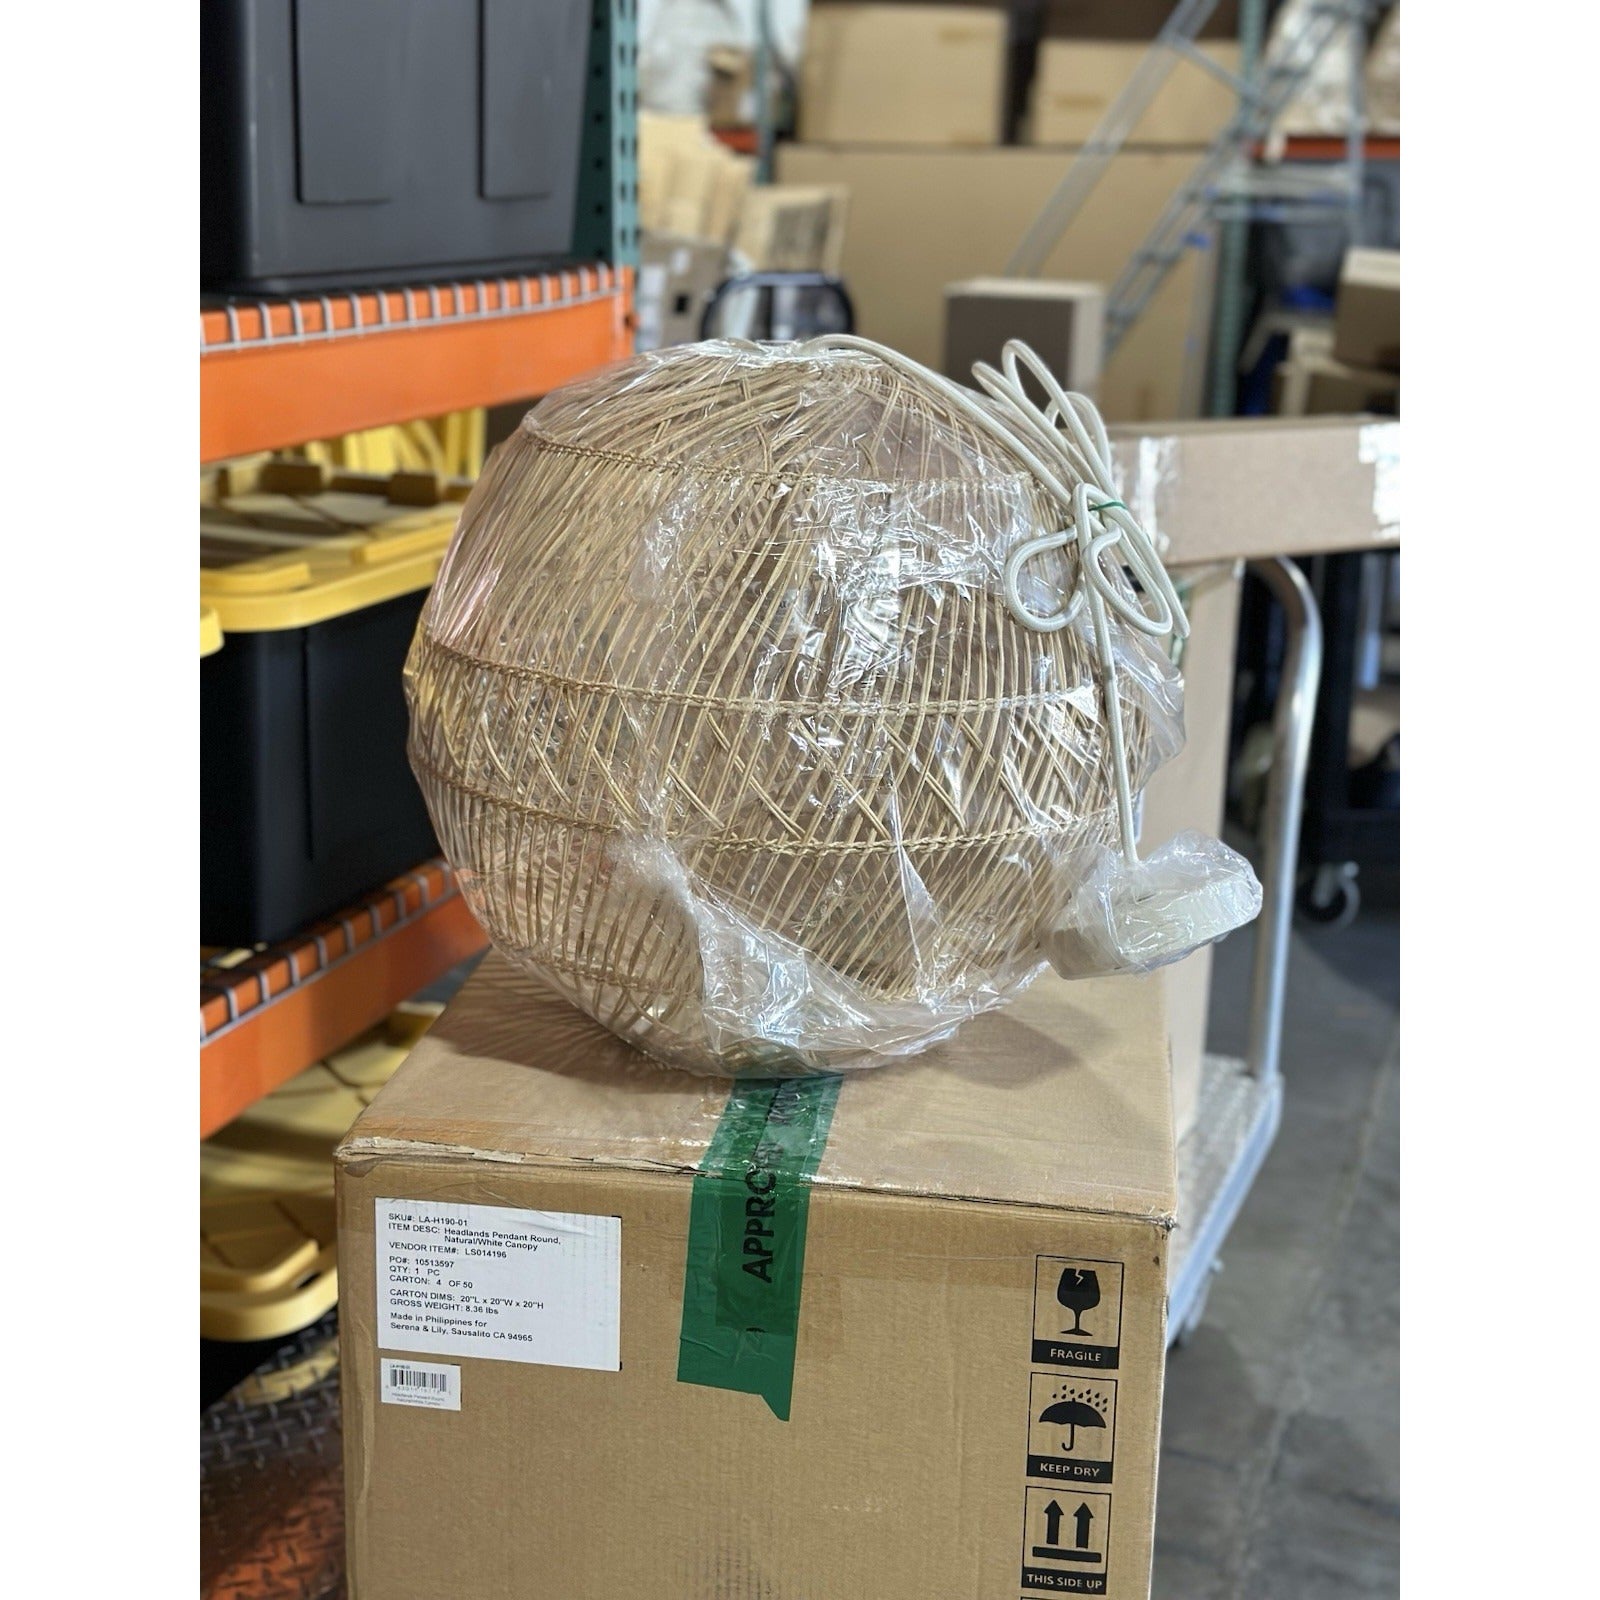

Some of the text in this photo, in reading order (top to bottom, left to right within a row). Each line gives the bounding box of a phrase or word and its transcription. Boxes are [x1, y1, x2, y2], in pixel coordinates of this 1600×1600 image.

[388, 1212, 468, 1226] SKU#: LA-H190-01
[388, 1222, 410, 1231] ITEM
[412, 1224, 441, 1234] DESC:
[444, 1227, 490, 1238] Headlands
[492, 1231, 528, 1241] Pendant
[389, 1241, 508, 1259] VENDOR ITEM#: LS014196
[444, 1235, 539, 1252] Natural/White Canopy
[389, 1255, 455, 1268] PO#: 10513597
[389, 1265, 411, 1274] QTY:
[427, 1268, 440, 1276] PC
[389, 1274, 431, 1285] CARTON:
[462, 1281, 473, 1289] 50
[389, 1288, 428, 1299] CARTON
[430, 1292, 455, 1302] DIMS:
[390, 1298, 500, 1315] GROSS WEIGHT: 8.36 lbs
[390, 1312, 487, 1328] Made in Philippines for
[390, 1321, 420, 1332] Serena
[451, 1327, 491, 1338] Sausalito
[493, 1331, 506, 1339] CA
[507, 1333, 534, 1342] 94965
[1050, 1348, 1101, 1362] FRAGILE
[1040, 1462, 1100, 1477] KEEP DRY
[1026, 1573, 1103, 1589] THIS SIDE UP
